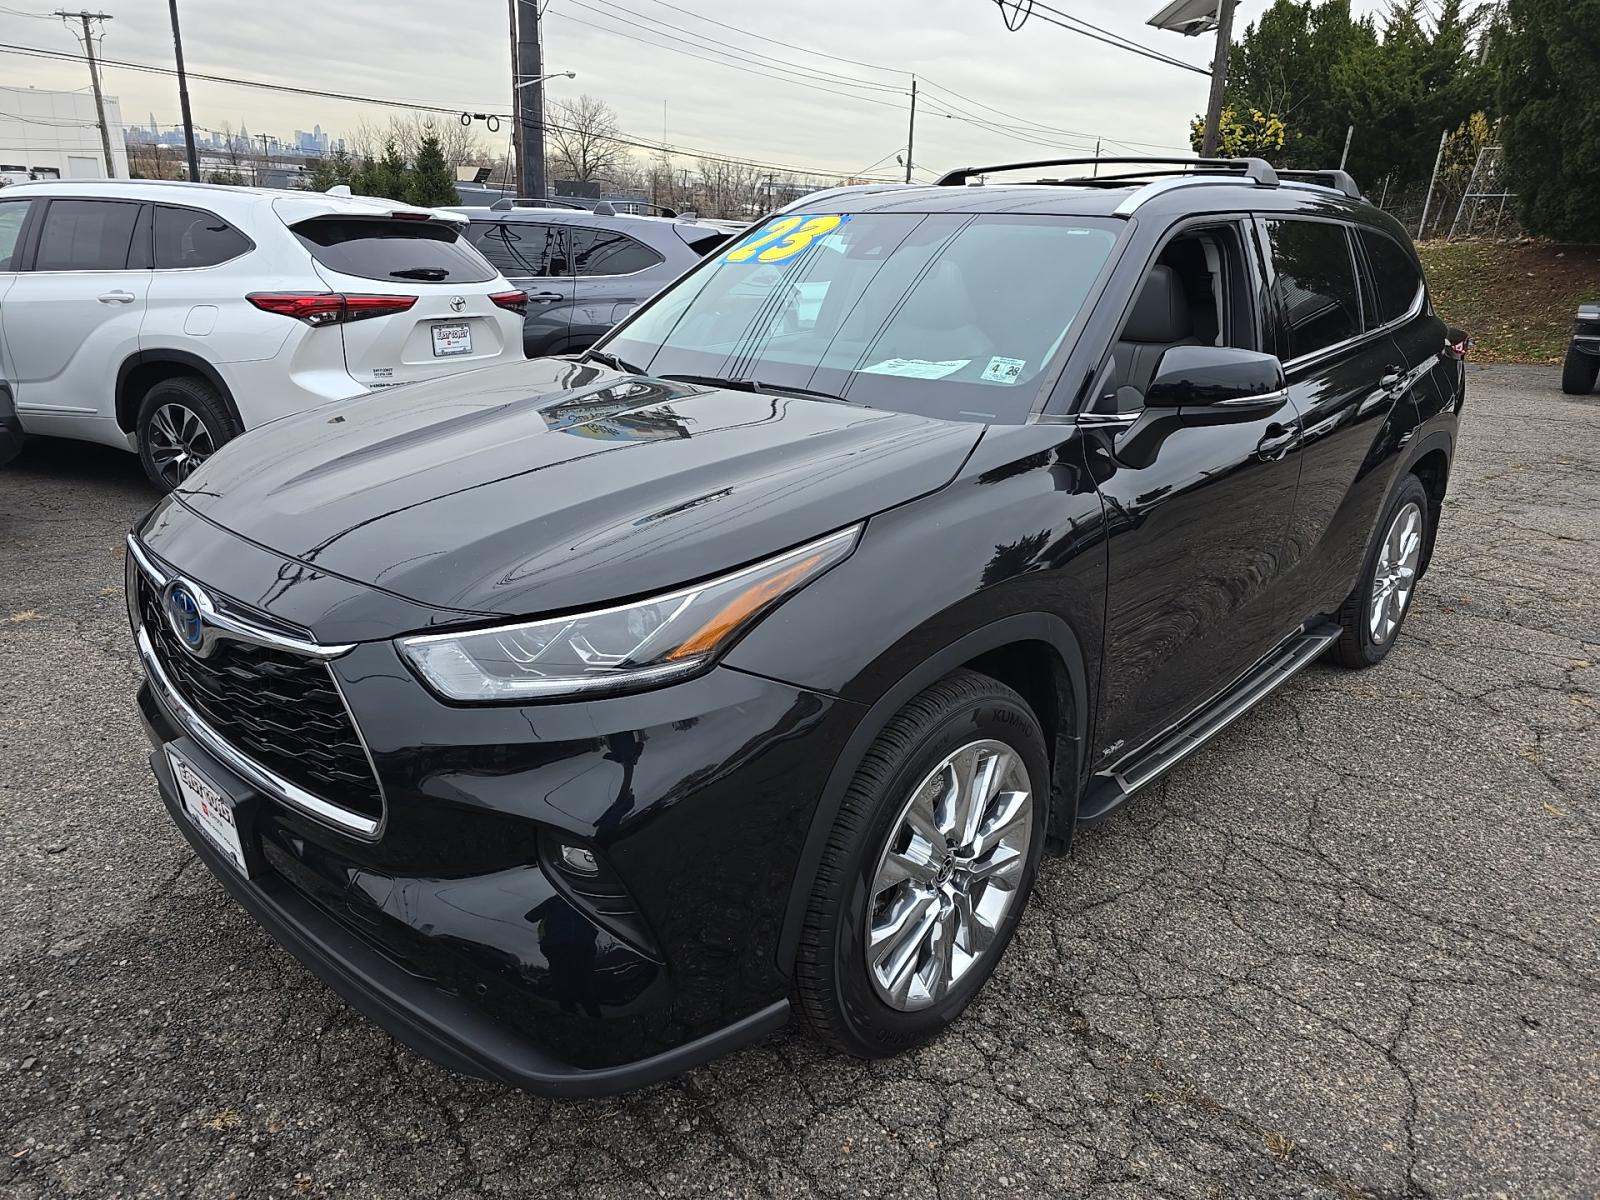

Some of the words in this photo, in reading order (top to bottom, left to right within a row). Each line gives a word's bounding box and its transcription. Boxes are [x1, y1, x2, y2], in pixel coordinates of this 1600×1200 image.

[726, 216, 841, 262] 23
[992, 364, 1000, 373] 4
[1005, 366, 1020, 376] 28
[992, 709, 1033, 737] KUMHO
